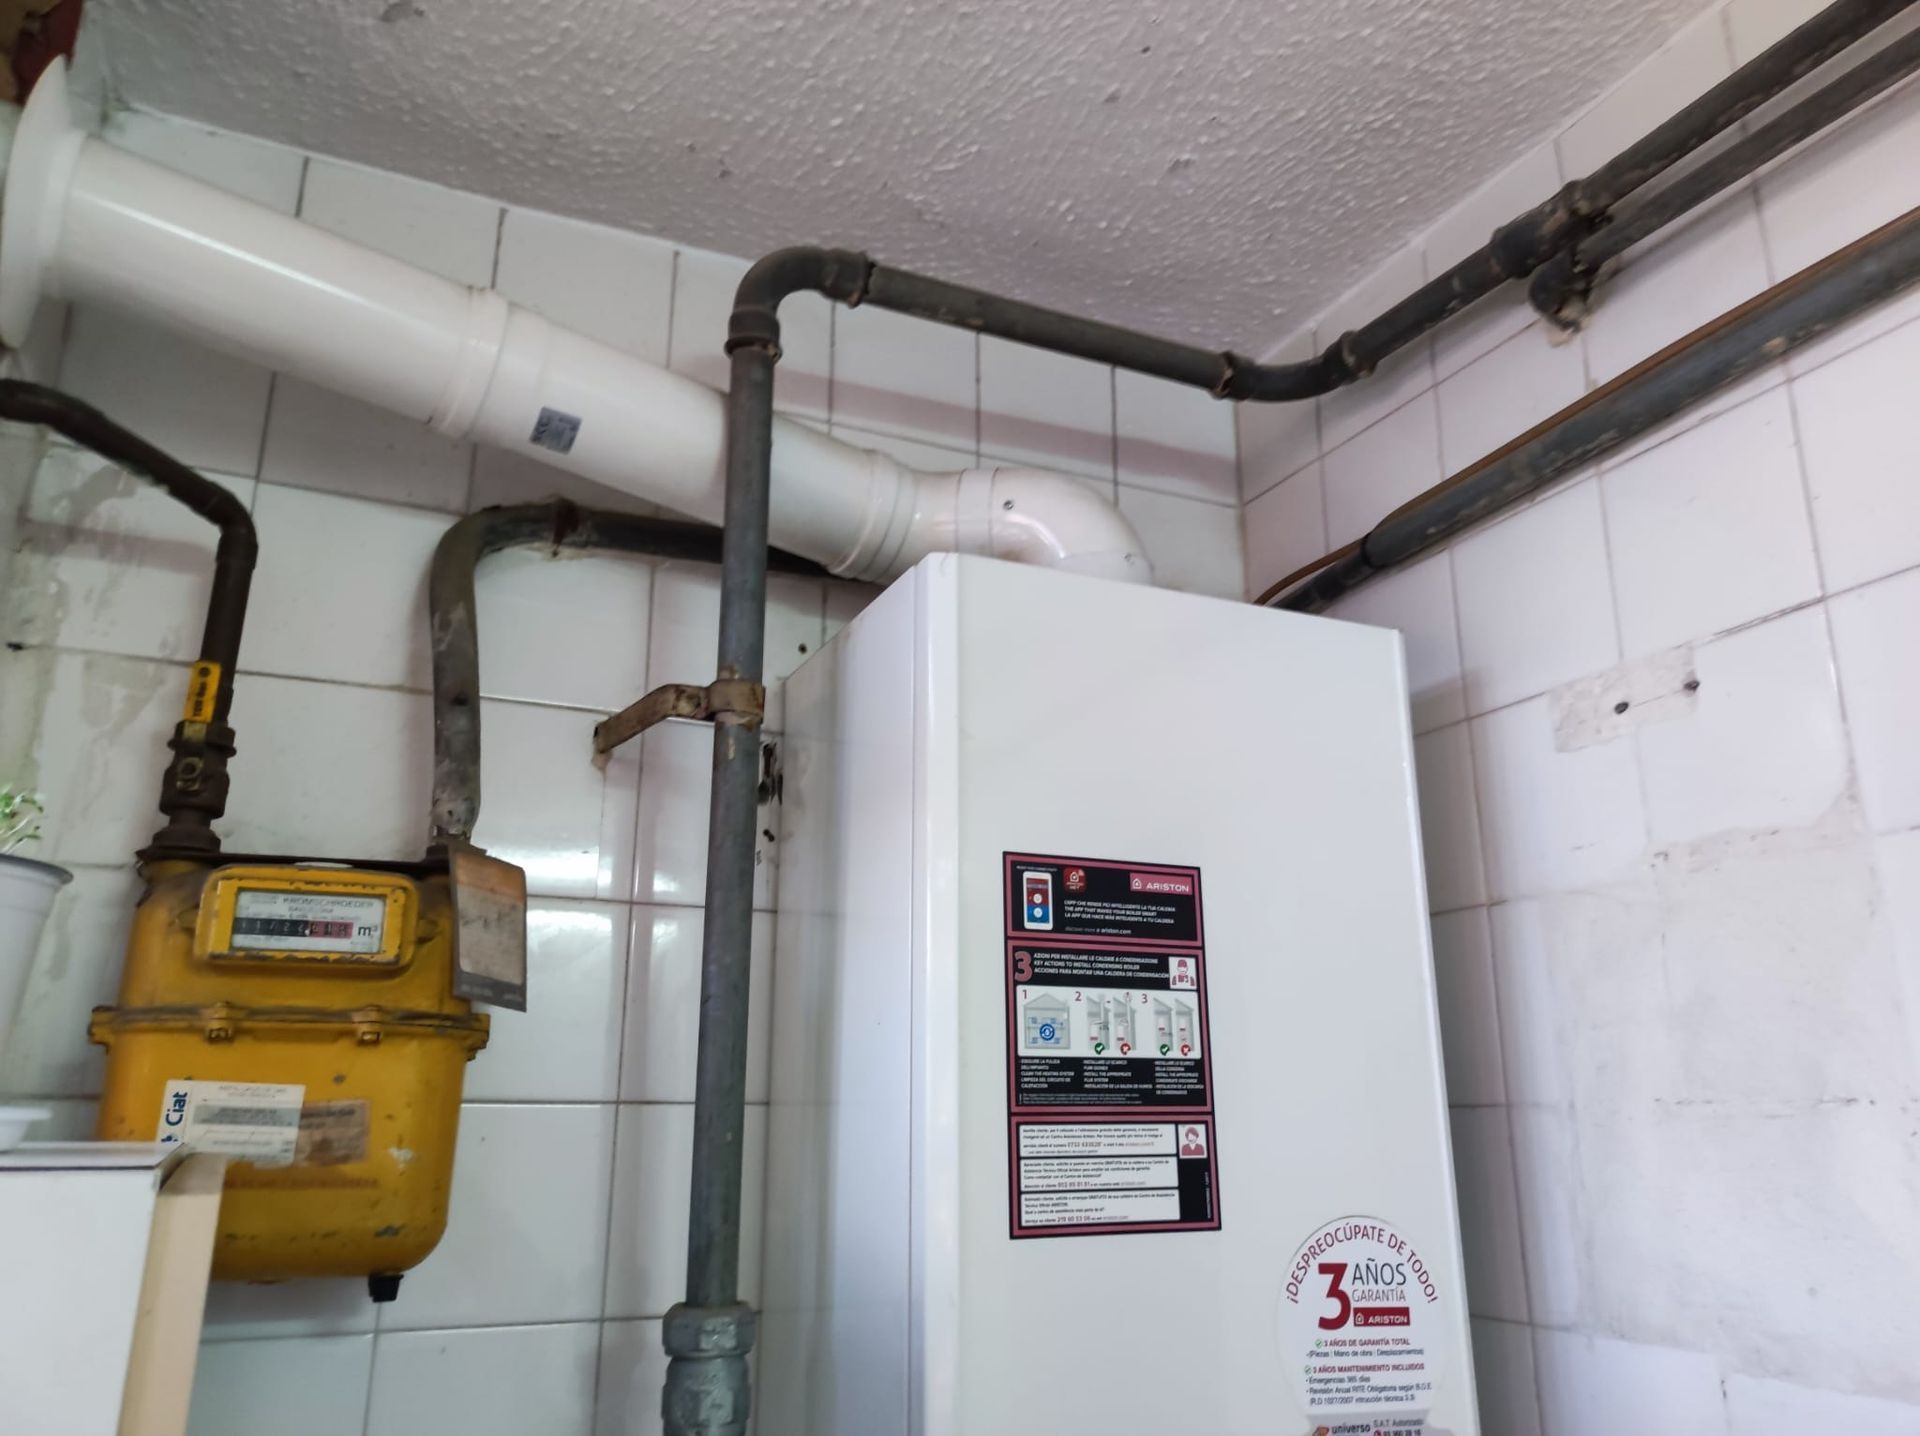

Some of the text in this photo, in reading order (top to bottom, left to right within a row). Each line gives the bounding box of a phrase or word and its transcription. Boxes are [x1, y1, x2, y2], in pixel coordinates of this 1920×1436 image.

[1146, 882, 1190, 892] ARISTON
[1014, 950, 1032, 982] 3
[1022, 989, 1028, 1000] 1
[1075, 991, 1082, 1002] 2
[1141, 993, 1148, 1004] 3
[165, 1091, 188, 1126] Ciat
[1286, 1222, 1438, 1304] ¡DESPREOCÚPATE DE TODO!
[1352, 1258, 1407, 1286] AÑOS
[1318, 1262, 1352, 1330] 3
[1352, 1287, 1406, 1302] GARANTÍA
[1368, 1315, 1408, 1324] ARISTON
[1329, 1338, 1347, 1346] AÑOS
[1359, 1337, 1390, 1346] GARANTÍA
[1318, 1365, 1336, 1373] AÑOS
[1338, 1364, 1390, 1372] MANTENIMIENTO
[1332, 1422, 1370, 1434] universo
